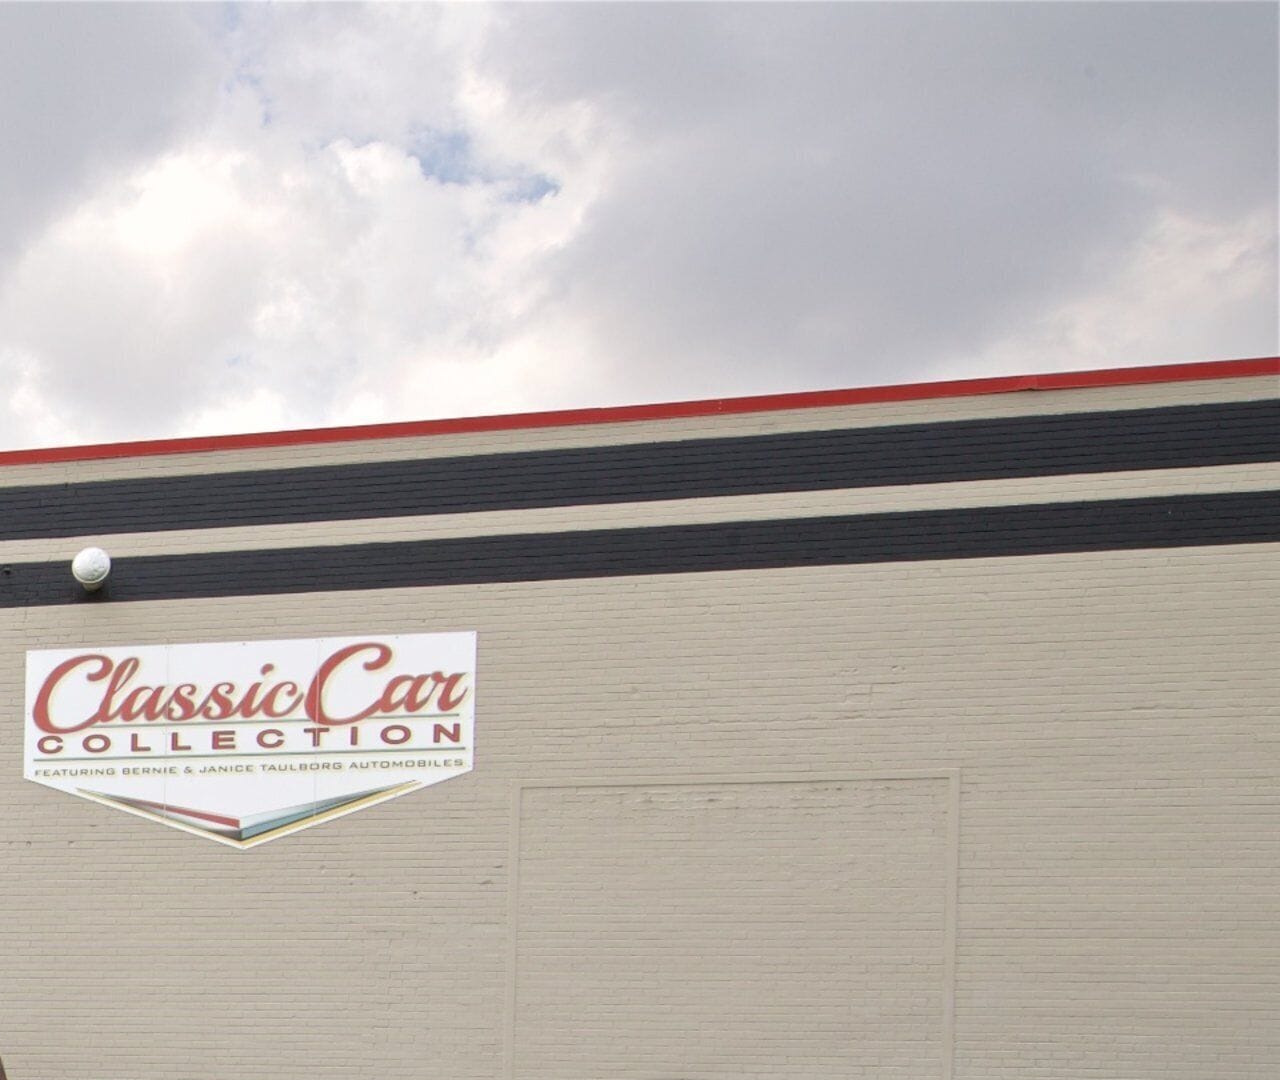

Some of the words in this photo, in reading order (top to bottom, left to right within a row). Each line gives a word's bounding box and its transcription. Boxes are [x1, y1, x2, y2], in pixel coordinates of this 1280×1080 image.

[32, 654, 303, 734] Classic
[304, 642, 469, 725] Car
[37, 723, 462, 755] COLLECTION
[35, 767, 115, 777] FEATURING
[122, 765, 177, 776] BERNIE
[183, 765, 193, 774] &
[199, 764, 254, 774] JANICE
[260, 761, 342, 772] TAULBORG
[349, 759, 464, 770] AUTOMOBILES
